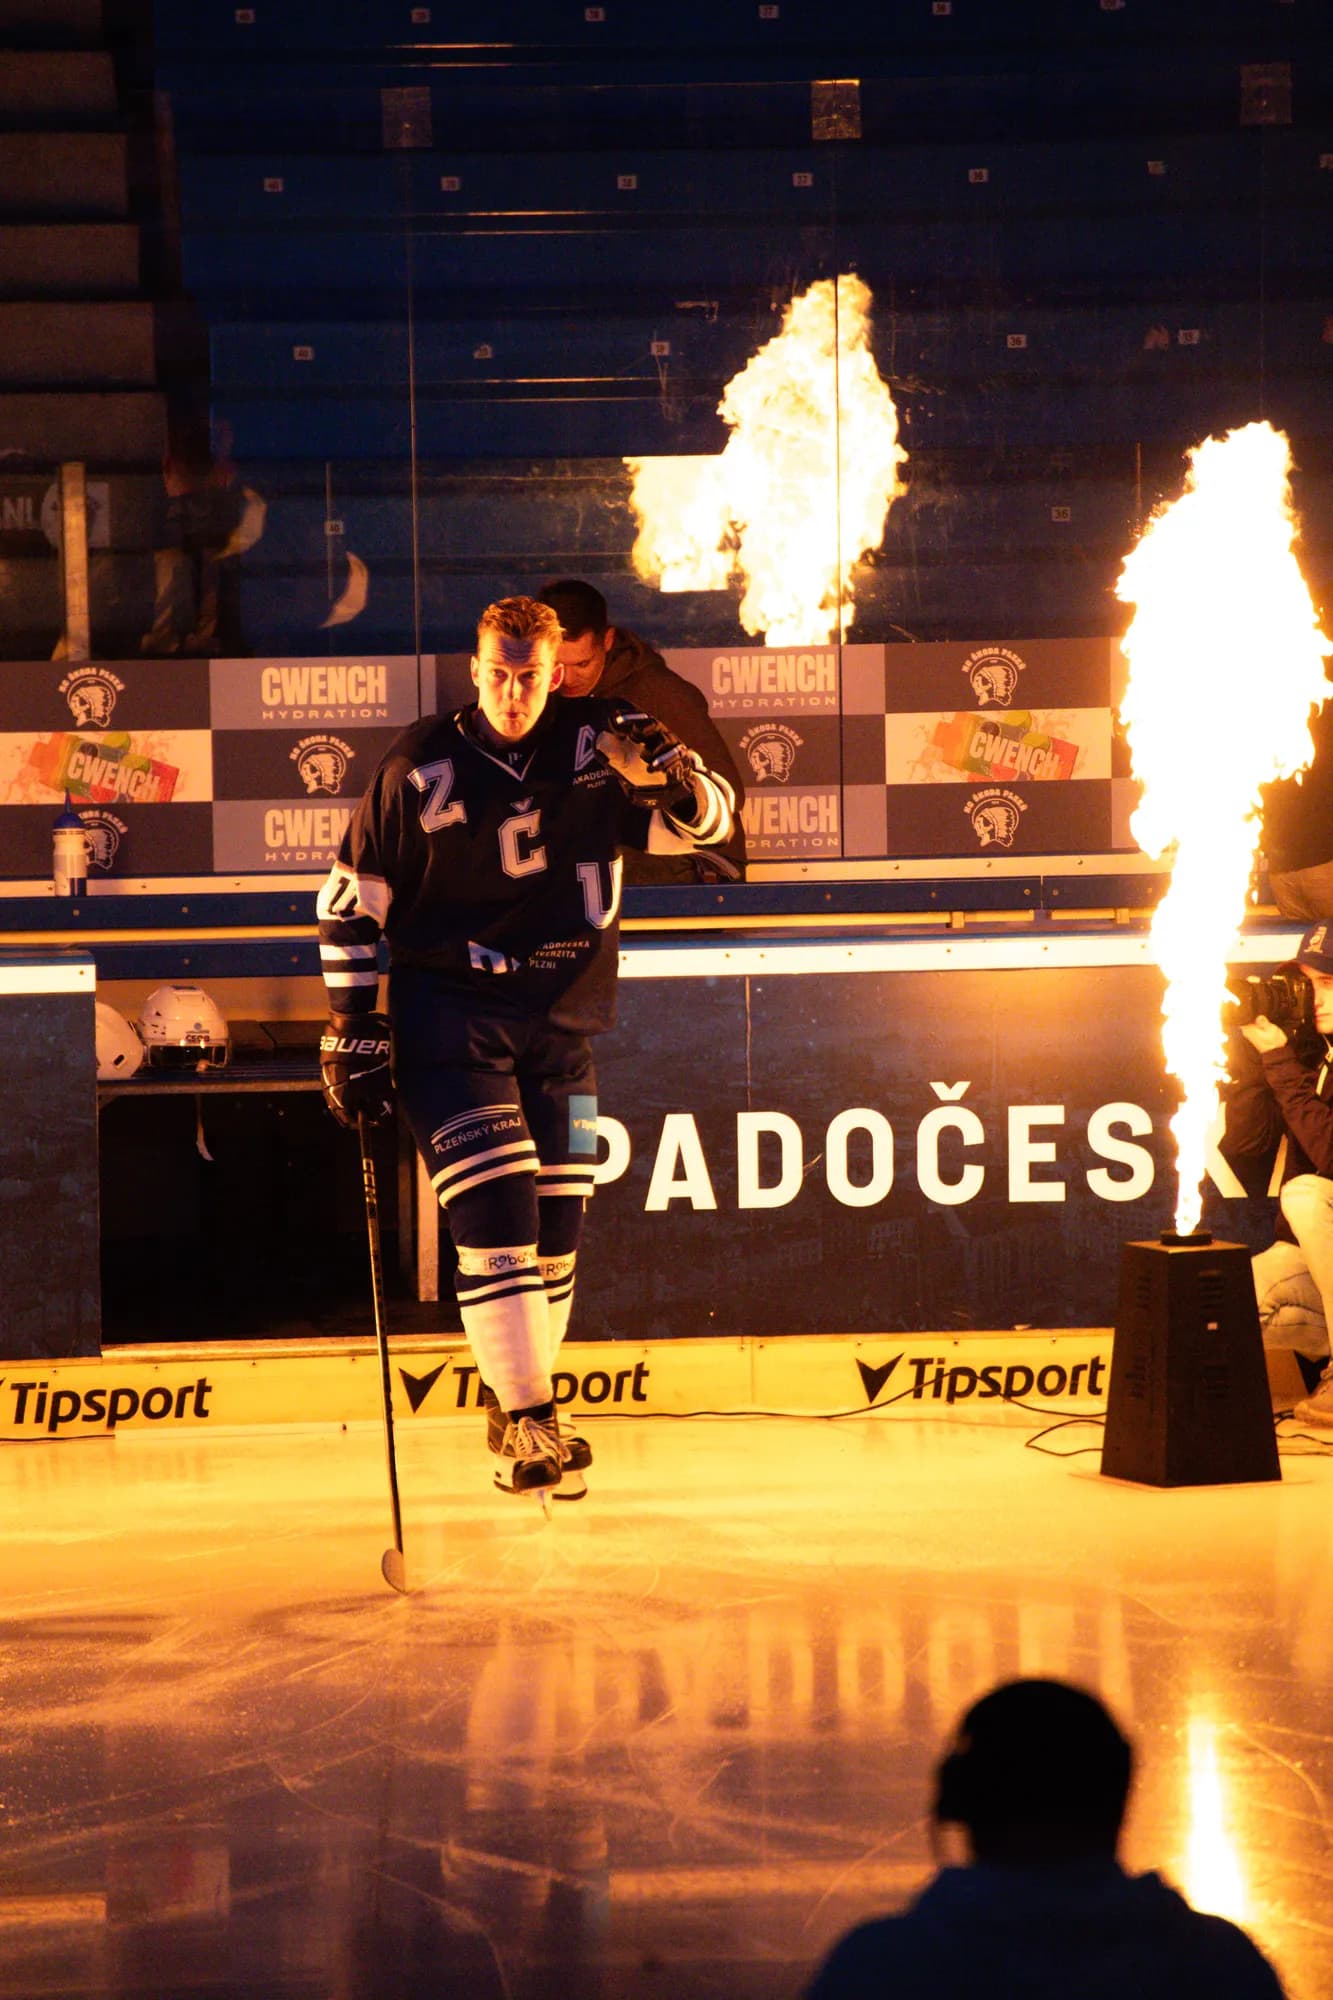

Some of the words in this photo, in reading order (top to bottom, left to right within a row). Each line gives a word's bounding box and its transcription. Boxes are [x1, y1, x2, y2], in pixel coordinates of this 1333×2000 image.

[261, 665, 387, 706] CWENCH
[712, 654, 835, 695] CWENCH
[262, 708, 387, 720] HYDRATION
[712, 696, 836, 708] HYDRATION
[67, 751, 161, 801] CWENCH
[969, 731, 1060, 780] CWENCH
[407, 759, 467, 834] Z
[741, 795, 838, 835] WENCH
[264, 808, 350, 847] CWEN
[498, 797, 549, 879] Č
[745, 838, 839, 848] DRATION
[265, 851, 338, 861] HYDRA
[491, 1116, 521, 1133] KRAJ
[909, 1356, 1106, 1404] Tipsport
[10, 1377, 212, 1432] Tipsport
